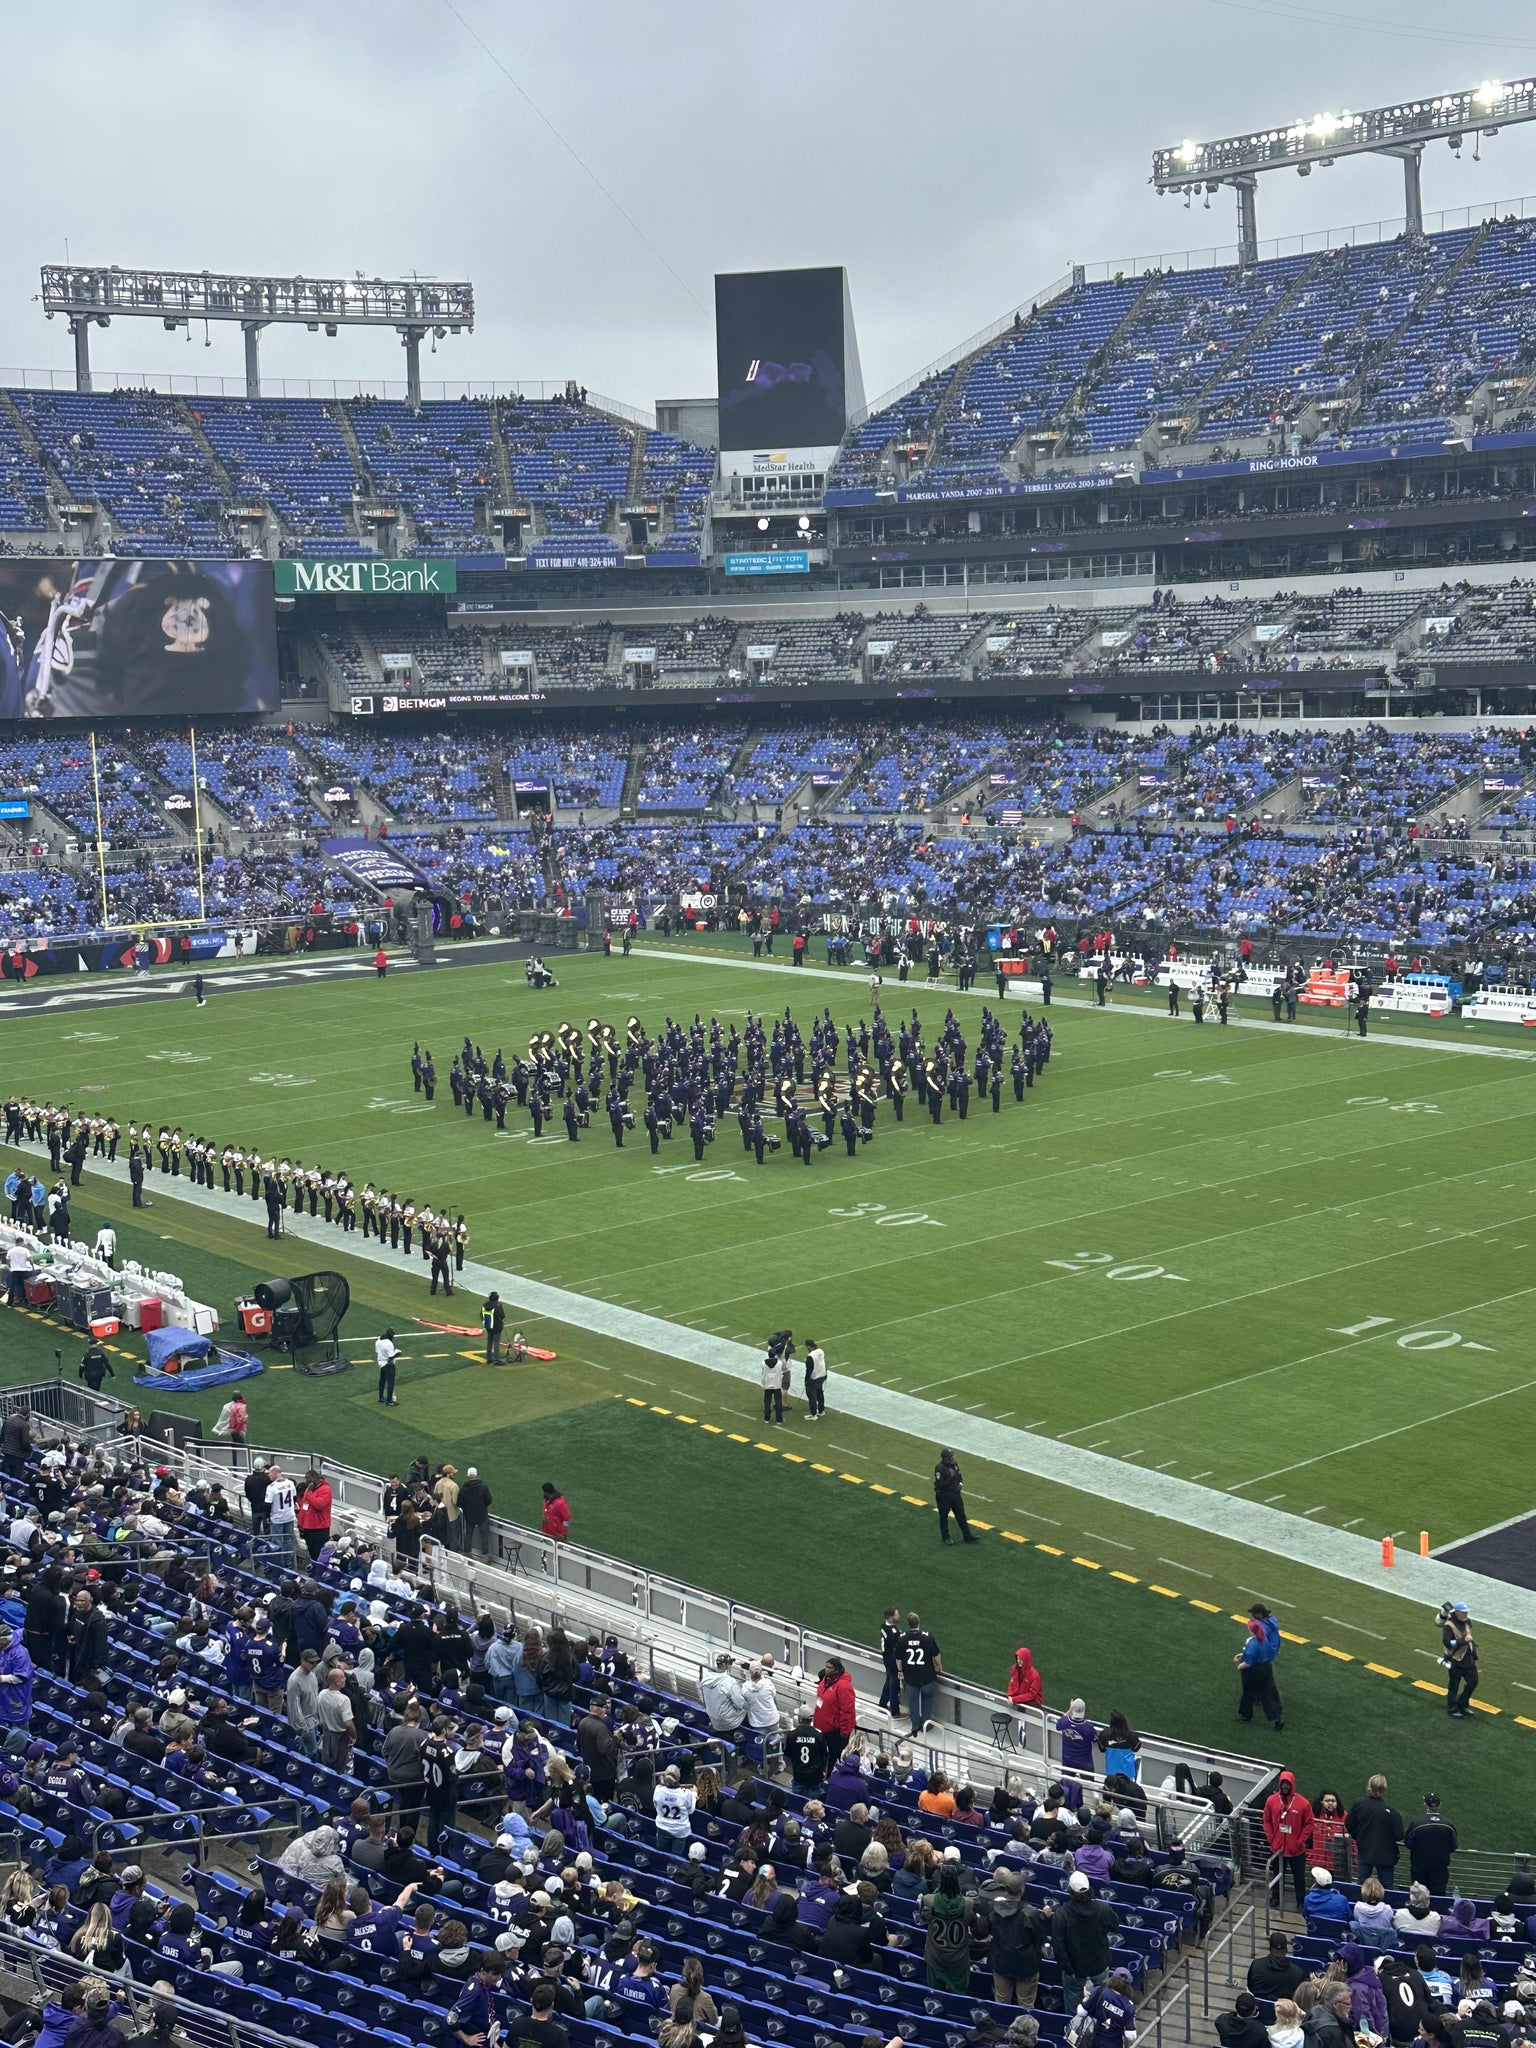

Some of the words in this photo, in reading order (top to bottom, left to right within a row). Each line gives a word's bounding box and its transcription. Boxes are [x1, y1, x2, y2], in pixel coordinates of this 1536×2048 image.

[753, 464, 786, 473] MedStar
[788, 462, 815, 471] Health
[1250, 461, 1273, 472] RING
[1280, 456, 1318, 469] HONOR
[906, 492, 939, 500] MARSHAL
[941, 490, 964, 498] YANDA
[1024, 484, 1052, 493] TERRELL
[1054, 481, 1077, 490] SUGGS
[536, 559, 549, 567] TEXT
[551, 559, 561, 567] FOR
[563, 558, 576, 567] HELP
[293, 563, 367, 592] M&T
[371, 563, 440, 591] Bank
[467, 603, 493, 611] BETMGM
[400, 698, 446, 709] BETMGM
[1490, 1000, 1526, 1008] RAVENS
[650, 1163, 736, 1182] 40
[828, 1202, 929, 1226] 30
[1043, 1251, 1165, 1281] 20
[251, 1312, 266, 1328] G
[104, 1324, 113, 1333] G
[1325, 1315, 1463, 1350] 10
[38, 1489, 45, 1501] 8
[279, 1492, 292, 1510] 14
[208, 1505, 215, 1517] 9
[390, 1497, 397, 1511] 4
[906, 1648, 925, 1666] 22
[252, 1657, 261, 1674] 8
[796, 1736, 816, 1744] JACKSON
[800, 1746, 810, 1764] 8
[422, 1758, 443, 1787] 20
[661, 1805, 681, 1820] 22
[718, 1879, 731, 1897] 2
[353, 1924, 377, 1938] JACKSON
[933, 1919, 966, 1946] 20
[595, 1965, 613, 1990] 14
[624, 1987, 646, 2001] FLOWERS
[1399, 1982, 1415, 2007] 0
[1103, 2000, 1125, 2018] FLOWERS
[1102, 2018, 1112, 2030] 4
